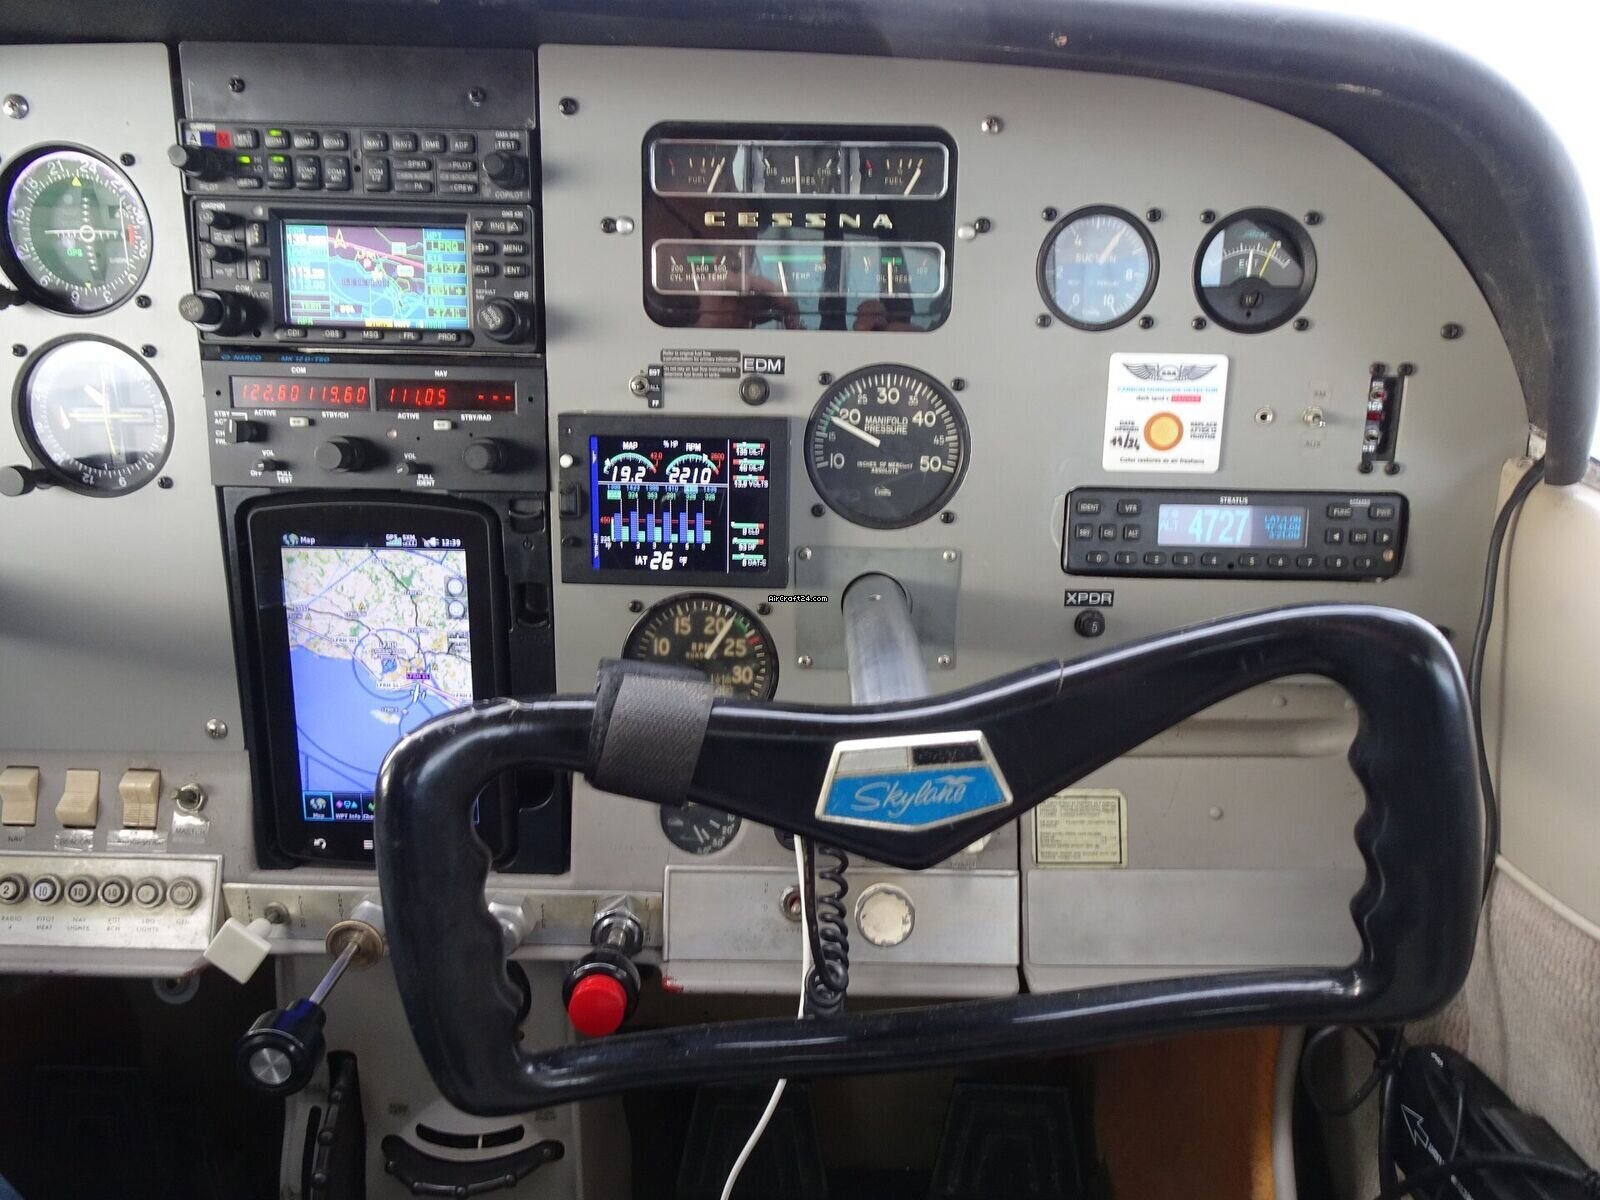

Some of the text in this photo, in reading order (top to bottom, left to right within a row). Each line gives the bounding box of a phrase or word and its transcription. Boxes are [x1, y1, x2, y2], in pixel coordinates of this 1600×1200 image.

[294, 138, 315, 146] COM2
[48, 160, 64, 176] 21
[80, 160, 98, 174] 24
[688, 176, 707, 184] FUEL
[781, 176, 816, 185] AMPRES
[885, 177, 904, 185] FUEL
[495, 191, 523, 199] COPILOT
[704, 211, 893, 229] CESSNA
[490, 222, 505, 231] RNG
[66, 248, 83, 258] GPS
[476, 265, 490, 273] CLR
[506, 266, 520, 274] ENT
[670, 273, 683, 281] CYL
[708, 273, 728, 281] TEMP
[792, 272, 811, 280] TEMP
[514, 291, 529, 299] GPS
[1072, 293, 1080, 305] 0
[1103, 293, 1115, 306] 10
[287, 329, 300, 337] CDI
[363, 331, 379, 339] MSG
[403, 332, 416, 340] FPL
[438, 333, 457, 341] PROC
[291, 366, 306, 374] COM
[743, 358, 782, 373] EDM
[242, 384, 366, 404] 122.60 119.60
[389, 388, 447, 406] 111.05
[877, 387, 900, 404] 30
[858, 394, 868, 405] 25
[254, 409, 277, 417] ACTIVE
[322, 411, 349, 419] STBY/CH
[397, 412, 420, 420] ACTIVE
[839, 408, 861, 425] 20
[865, 416, 909, 425] MANIFOLD
[912, 410, 936, 427] 40
[864, 424, 908, 434] PRESSURE
[829, 432, 836, 441] 15
[934, 435, 945, 446] 45
[623, 441, 638, 450] MAP
[686, 443, 702, 452] RPM
[830, 453, 845, 469] 10
[920, 456, 942, 472] 50
[81, 472, 96, 486] 12
[612, 466, 646, 482] 19.2
[669, 467, 712, 484] 2210
[749, 480, 769, 488] VOLTS
[1220, 496, 1249, 505] STRATUS
[1125, 504, 1137, 512] VFR
[1189, 509, 1249, 544] 4727
[1128, 529, 1139, 537] ALT
[300, 536, 316, 546] Map
[442, 538, 461, 547] 12:39
[635, 555, 648, 565] IAT
[650, 551, 673, 570] 26
[1066, 592, 1112, 605] XPDR
[675, 616, 691, 635] 15
[704, 616, 727, 635] 20
[653, 638, 670, 656] 10
[724, 638, 747, 657] 25
[732, 666, 753, 685] 30
[851, 777, 966, 819] Skylane
[3, 884, 10, 895] 2
[39, 886, 48, 897] 10
[74, 887, 84, 897] 10
[107, 888, 118, 896] 10
